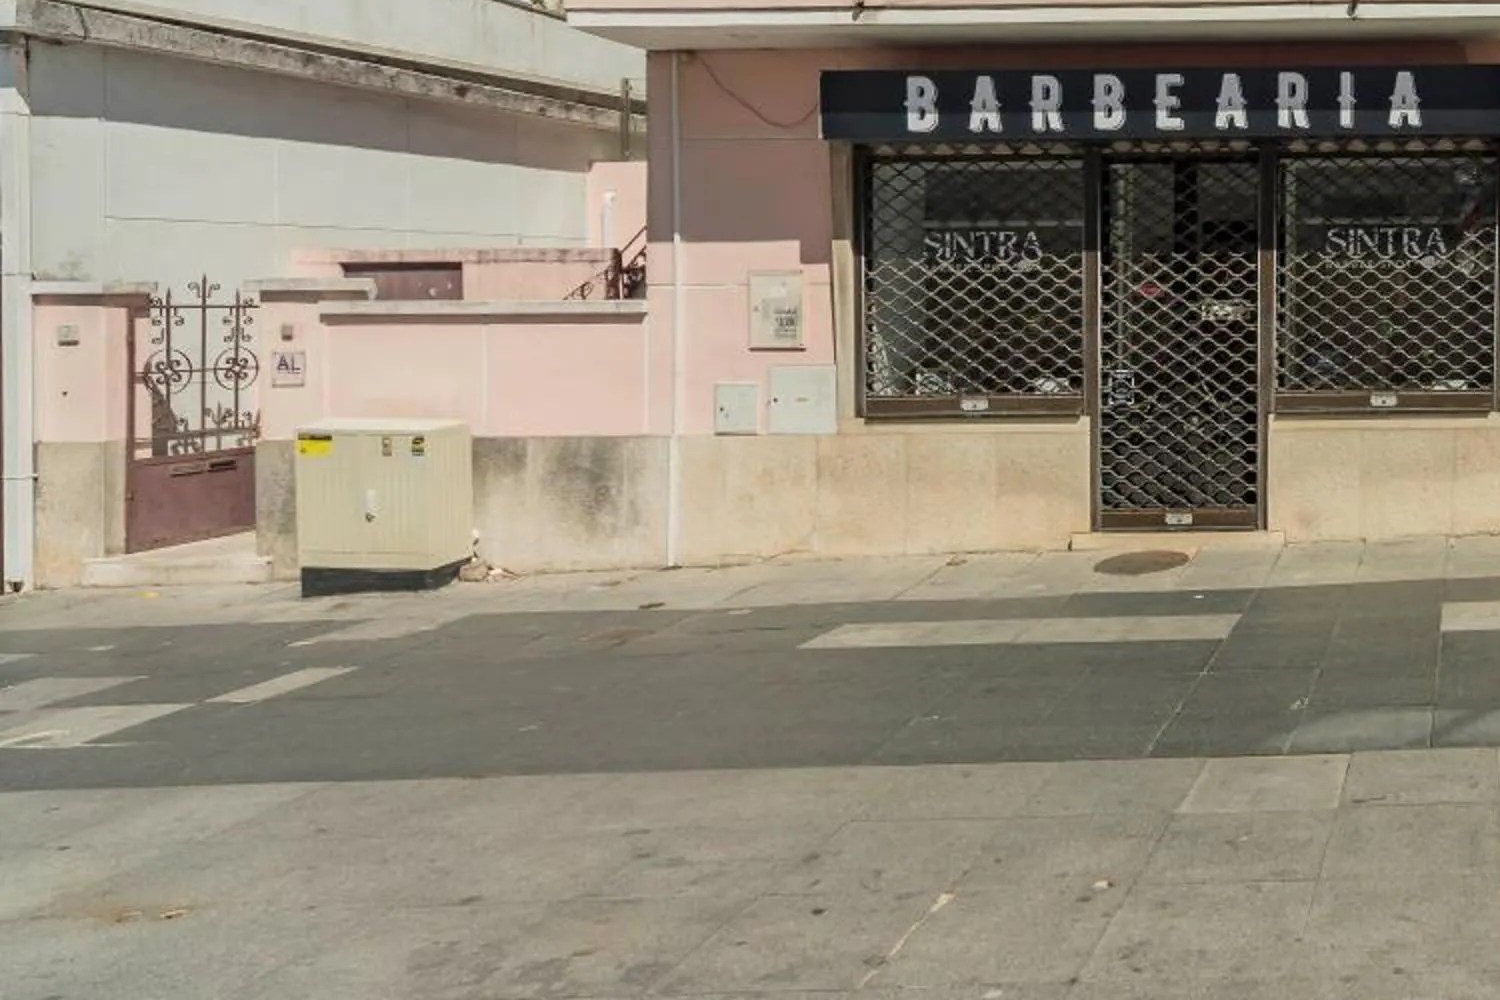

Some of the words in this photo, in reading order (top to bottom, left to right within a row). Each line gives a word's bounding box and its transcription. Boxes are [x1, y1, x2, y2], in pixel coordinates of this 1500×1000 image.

[904, 71, 1422, 133] BARBEARIA
[924, 231, 1043, 259] SINTRA
[1325, 228, 1447, 256] SINTRA
[277, 353, 302, 371] AL
